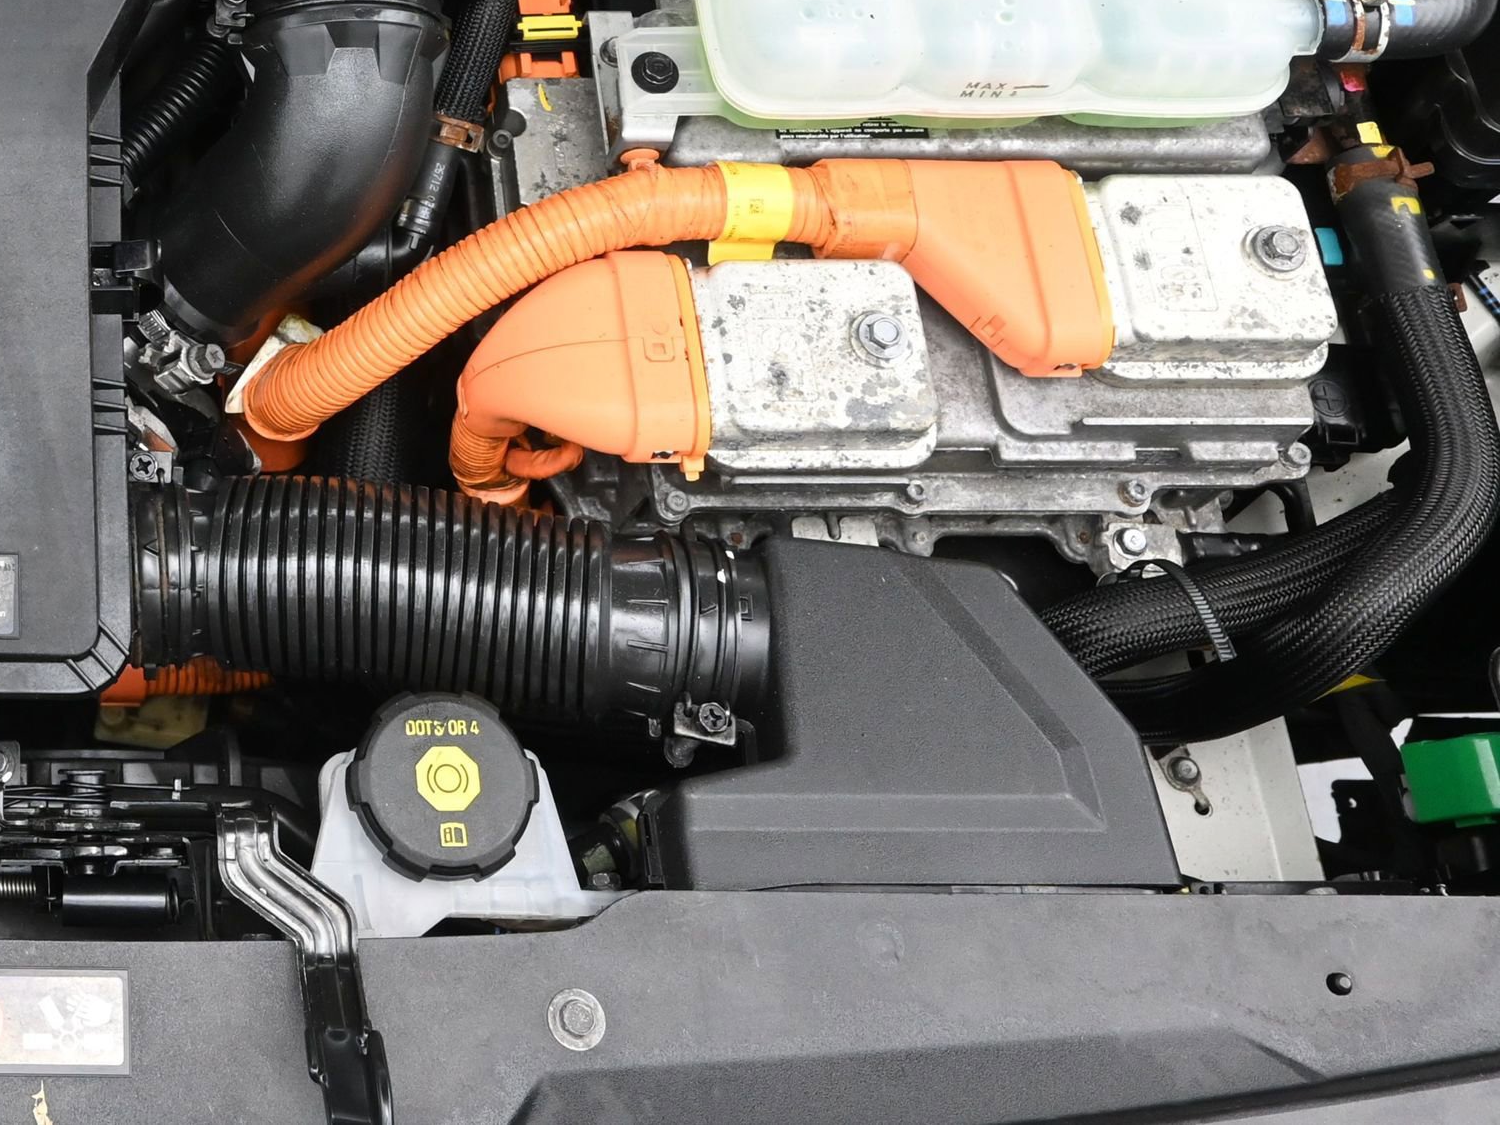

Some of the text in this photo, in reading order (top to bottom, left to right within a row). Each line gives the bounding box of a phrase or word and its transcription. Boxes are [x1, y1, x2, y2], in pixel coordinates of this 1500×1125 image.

[966, 82, 1007, 90] MAX
[960, 90, 1002, 98] MIN
[448, 719, 467, 735] OR
[470, 720, 480, 735] 4
